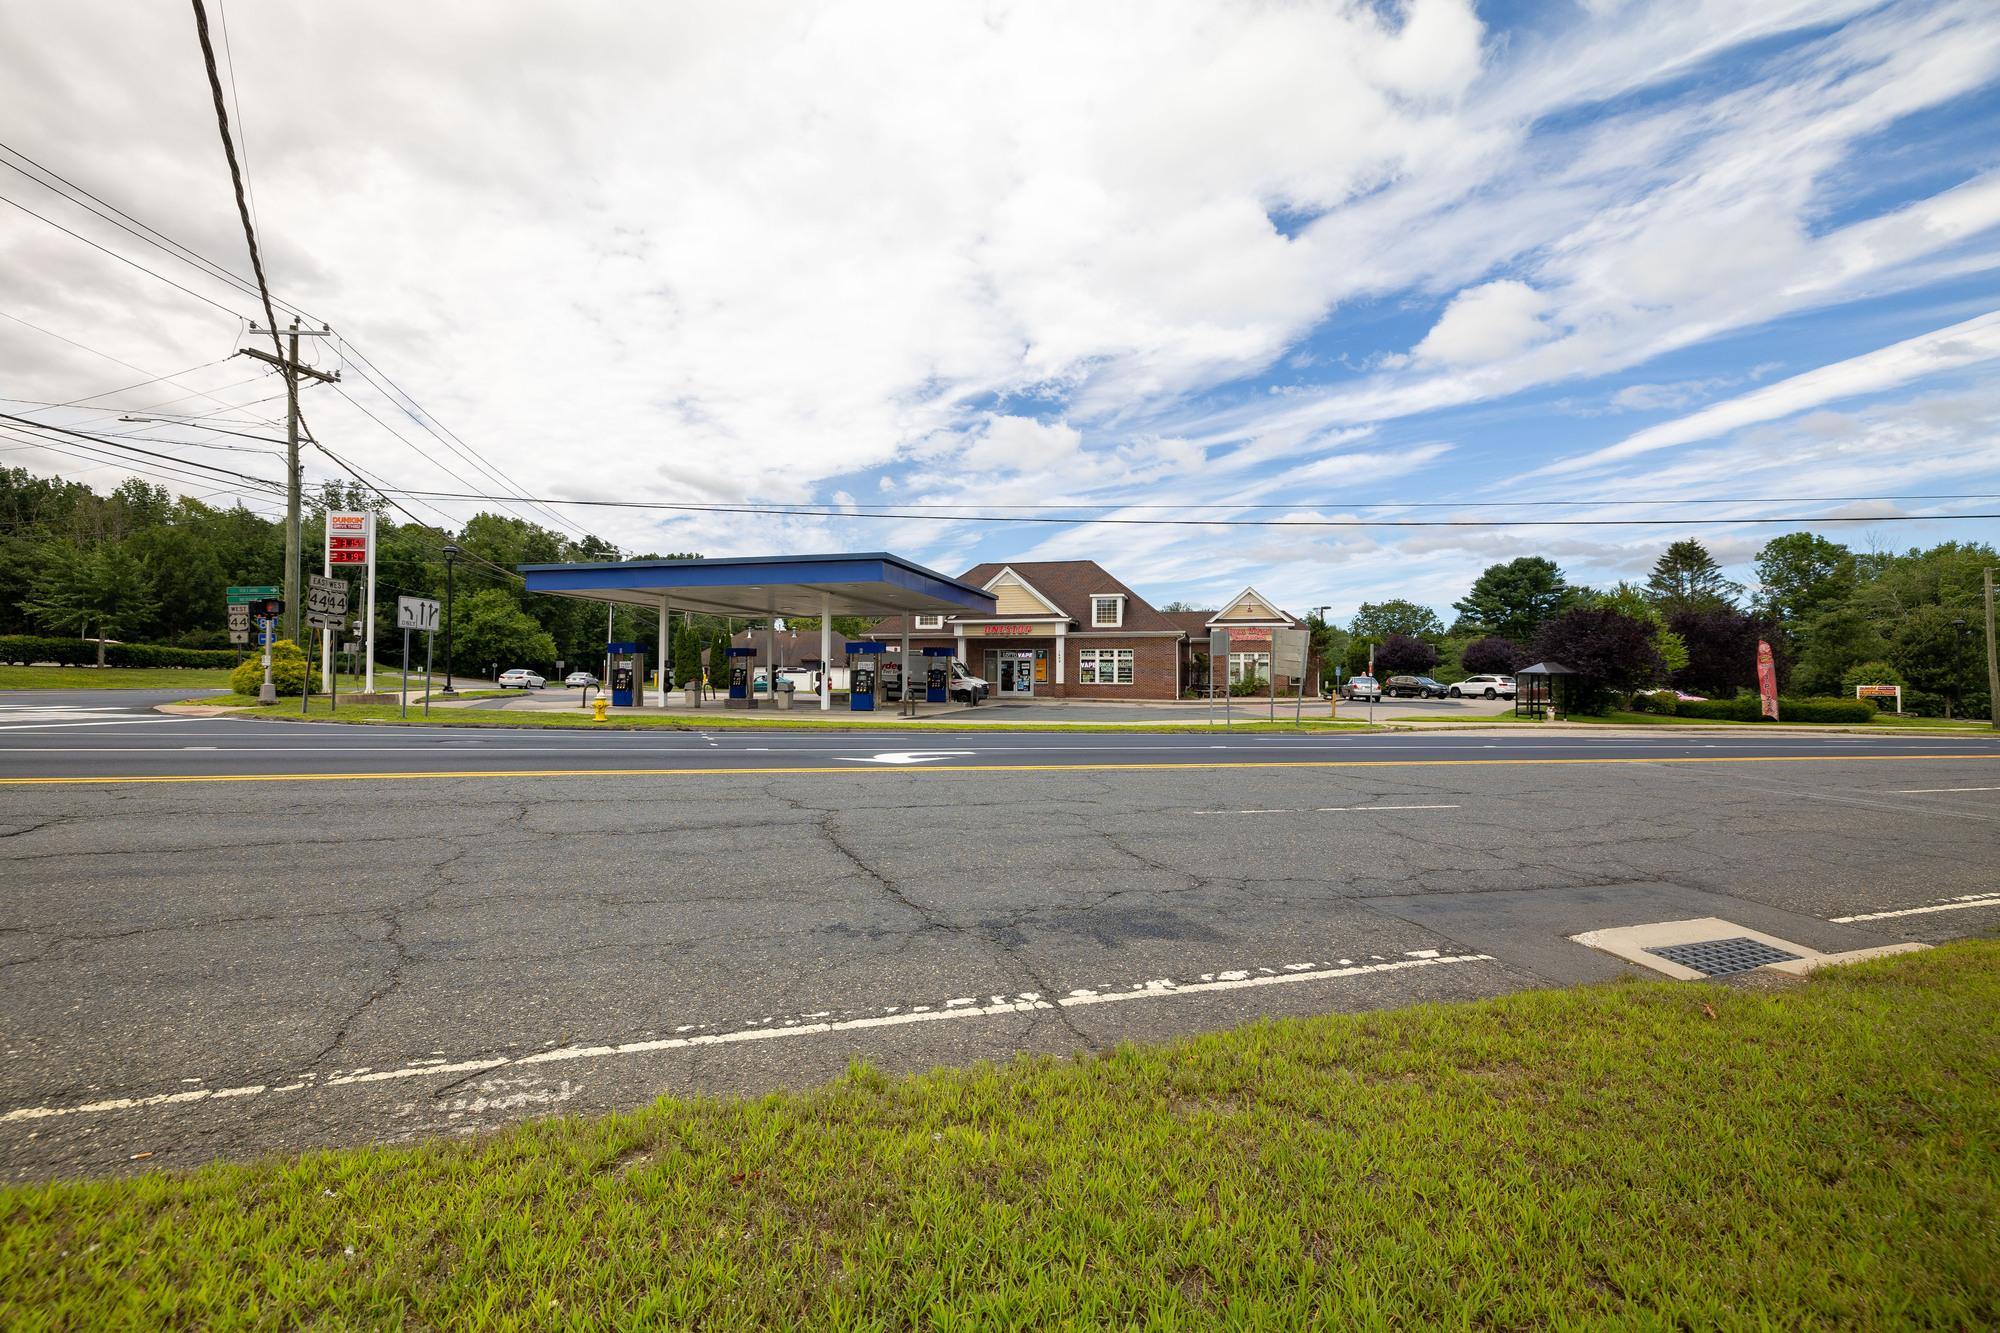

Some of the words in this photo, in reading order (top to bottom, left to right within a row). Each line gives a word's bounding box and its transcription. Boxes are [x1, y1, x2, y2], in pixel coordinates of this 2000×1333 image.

[329, 581, 345, 590] WEST
[309, 593, 328, 607] 44
[329, 597, 345, 609] 44
[230, 618, 247, 627] 44
[984, 625, 1032, 634] ONESTOP
